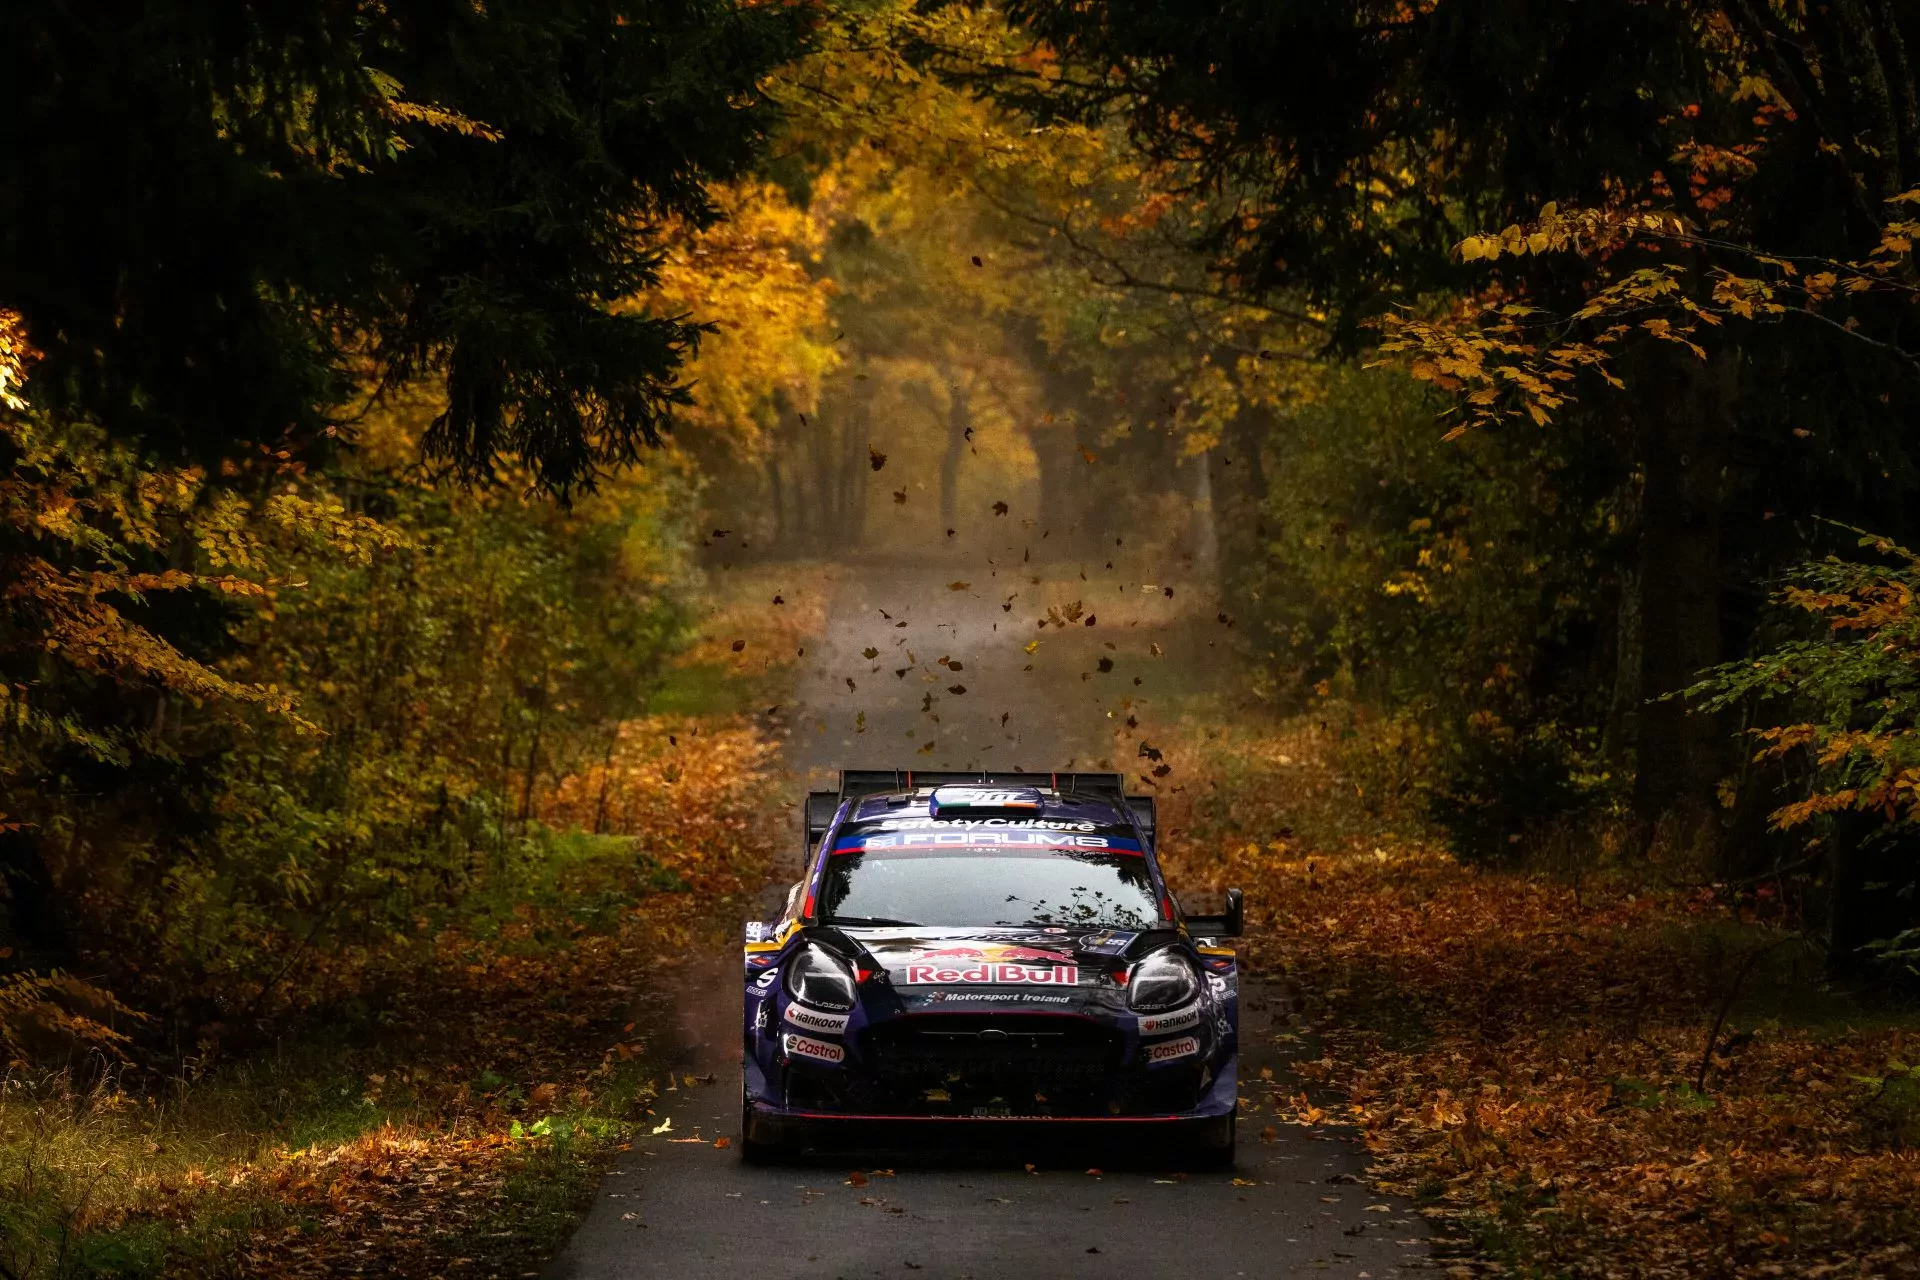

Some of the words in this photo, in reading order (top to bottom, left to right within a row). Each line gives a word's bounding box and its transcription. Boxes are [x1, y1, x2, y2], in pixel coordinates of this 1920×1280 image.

[903, 832, 1109, 848] FORUM8
[908, 964, 990, 984] Red
[1000, 965, 1077, 985] Bull
[945, 993, 1020, 1002] Motorsport
[1022, 994, 1070, 1004] Ireland
[796, 1040, 841, 1060] Castrol
[1153, 1040, 1195, 1059] Castrol
